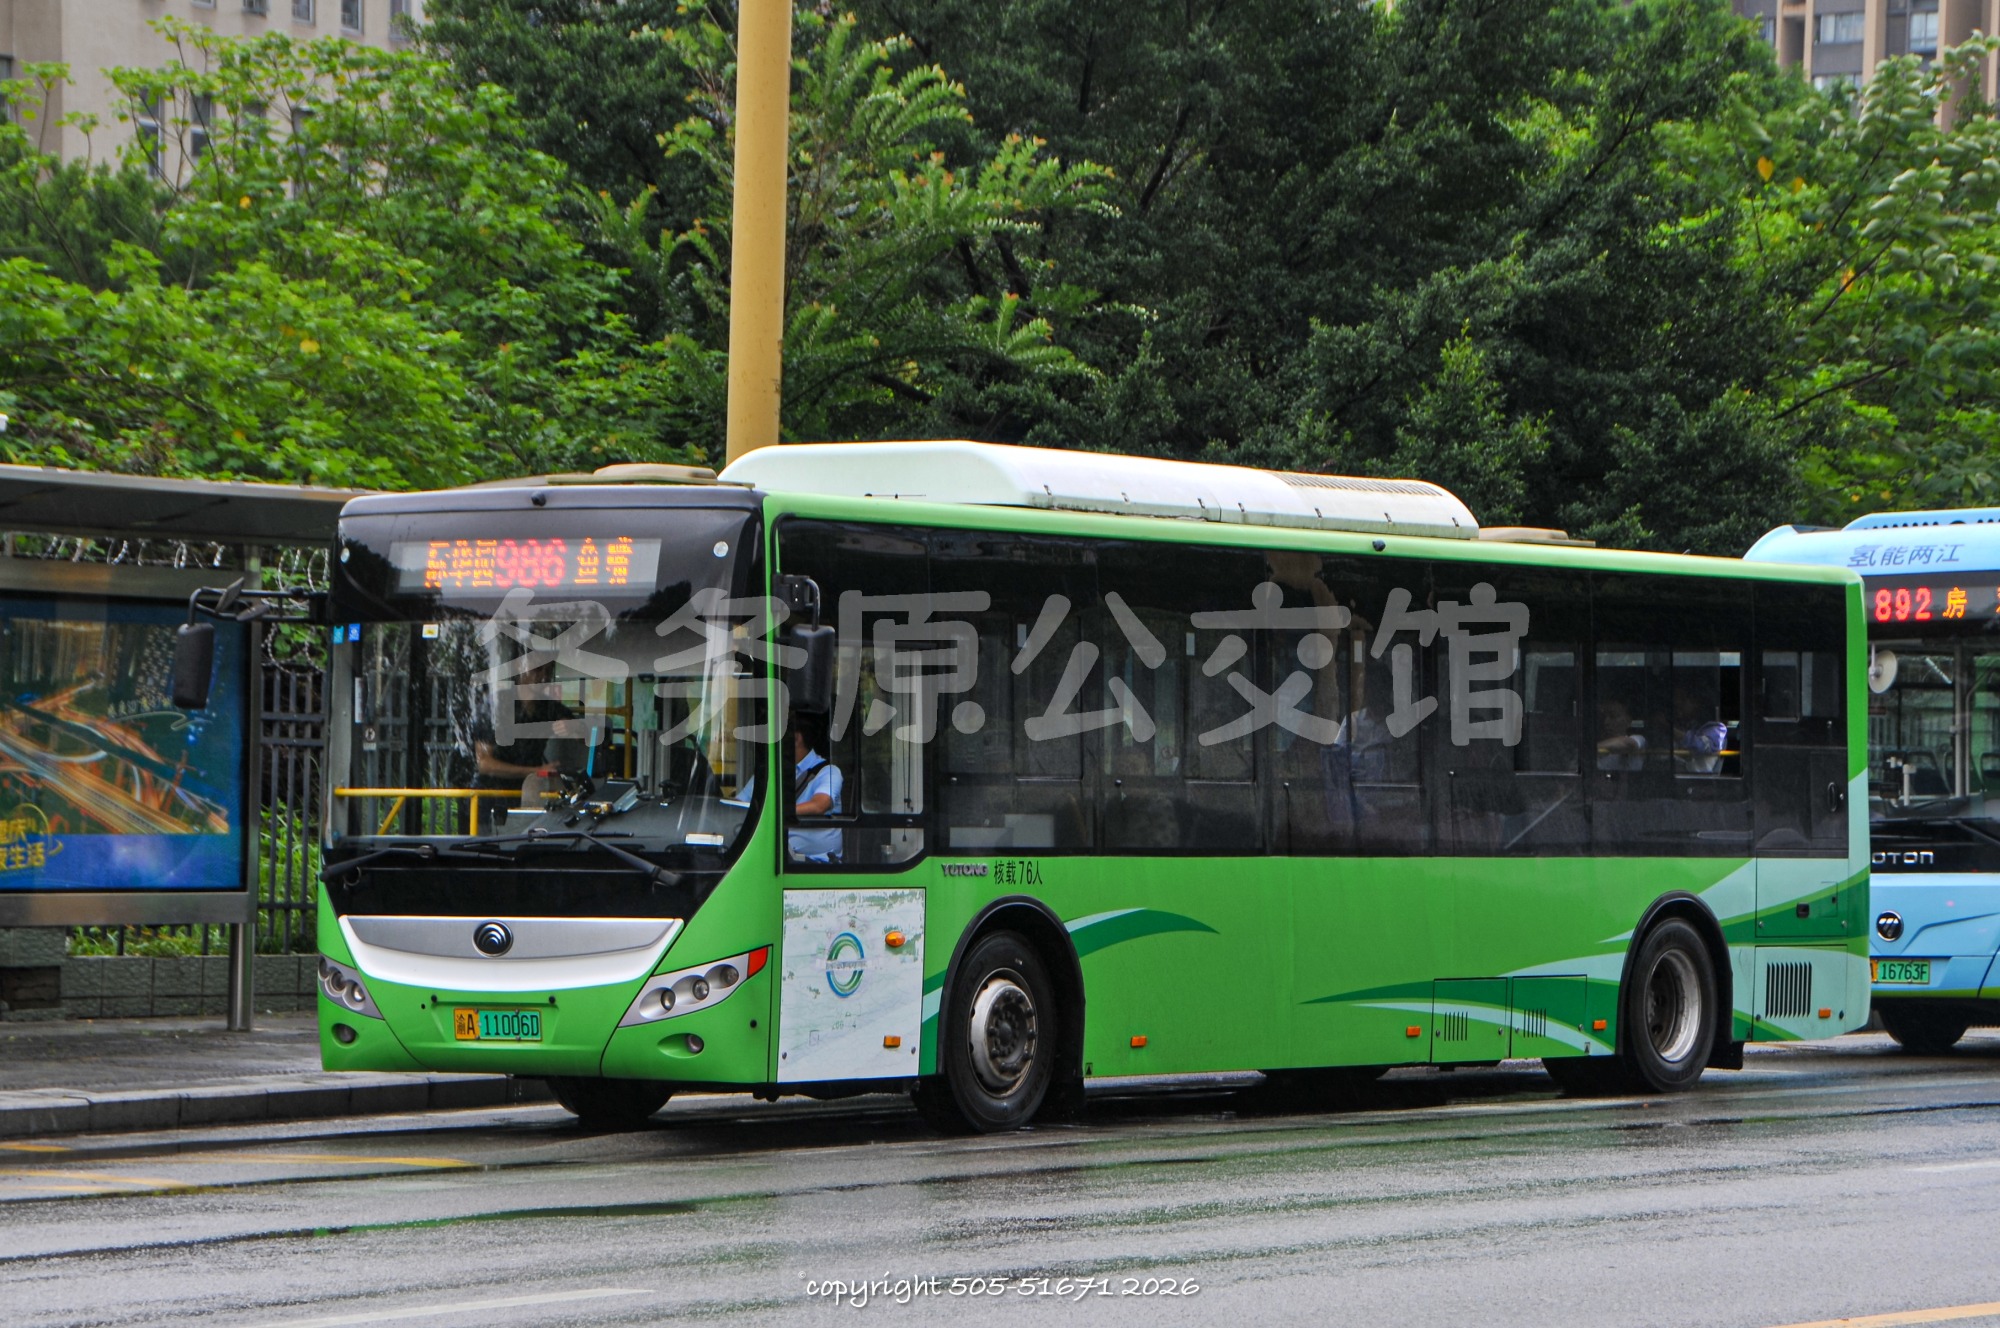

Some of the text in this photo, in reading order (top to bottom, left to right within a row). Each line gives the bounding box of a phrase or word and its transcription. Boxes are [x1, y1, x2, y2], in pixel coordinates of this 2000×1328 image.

[496, 538, 568, 588] 986
[1847, 544, 1965, 568] 氢能两江
[1875, 587, 1932, 622] 892
[941, 863, 989, 877] YUTONG
[993, 860, 1043, 885] 核载76人
